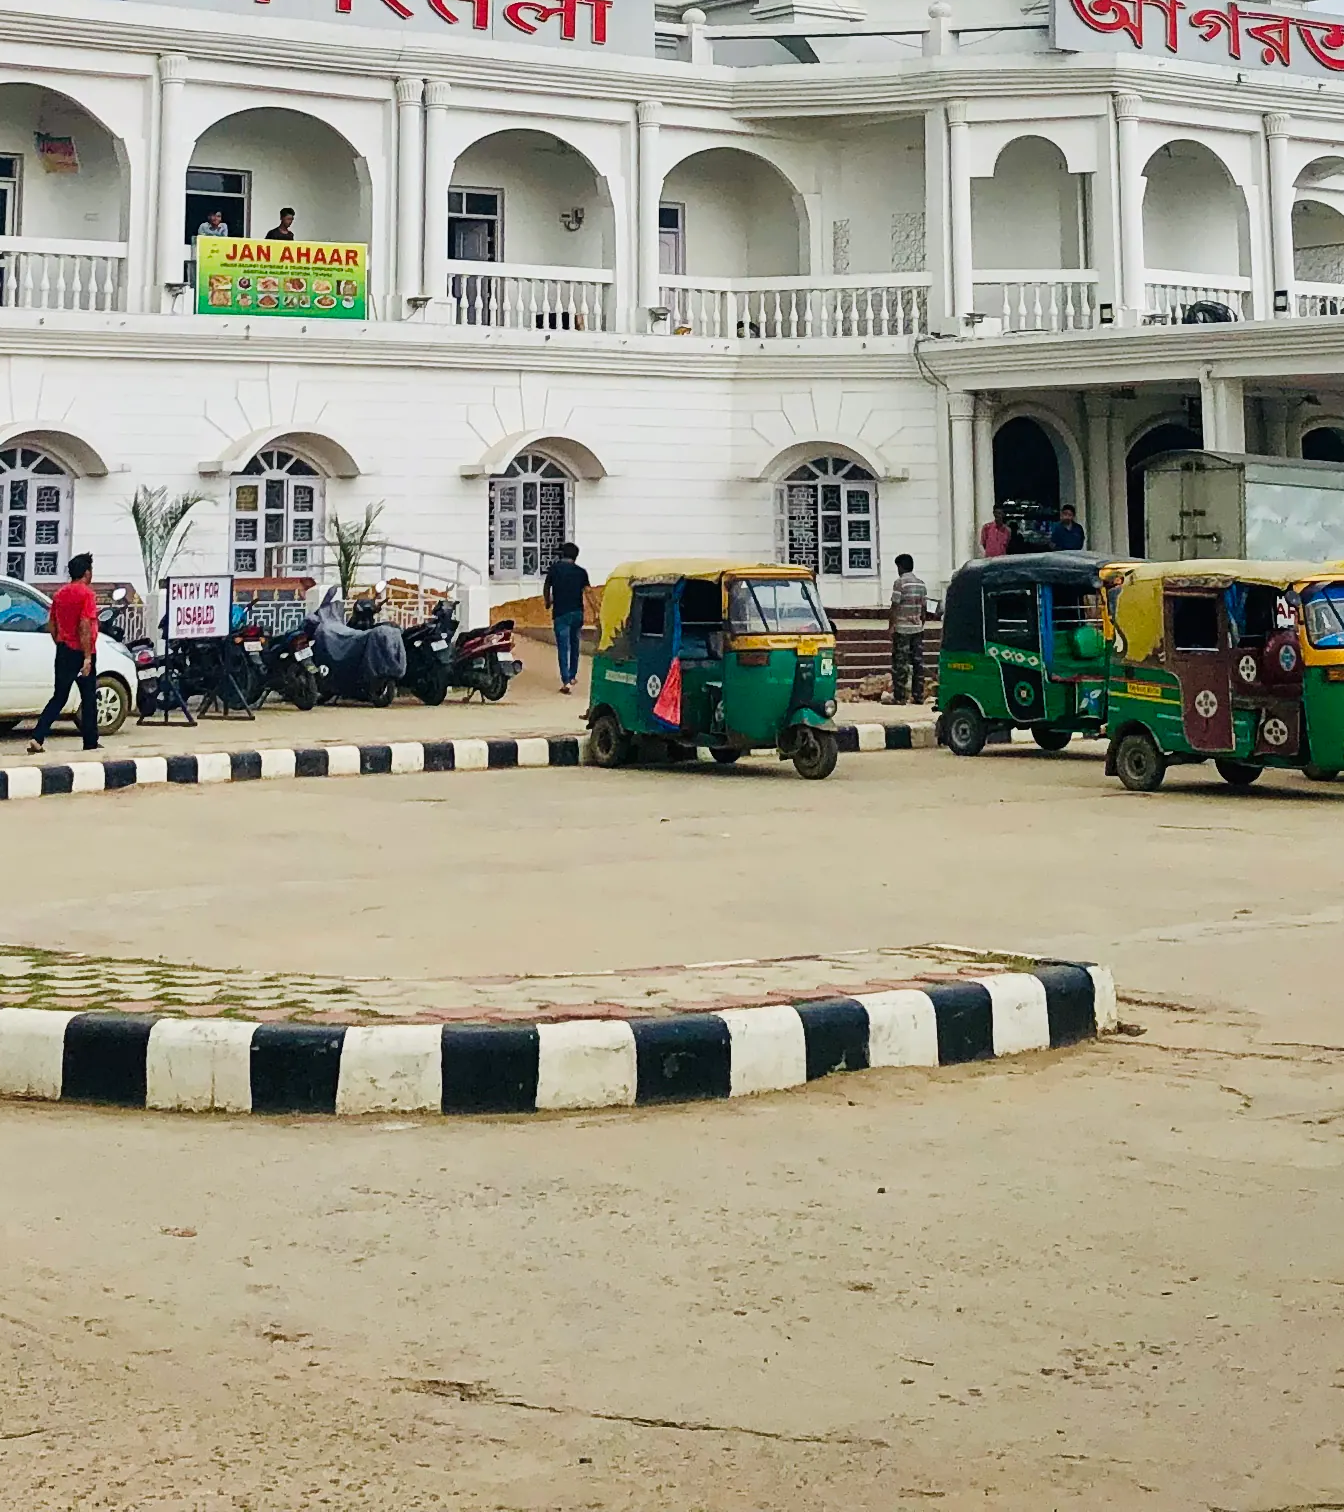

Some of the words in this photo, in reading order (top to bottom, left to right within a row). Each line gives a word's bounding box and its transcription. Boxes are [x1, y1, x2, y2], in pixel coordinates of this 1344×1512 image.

[225, 243, 271, 263] JAN
[279, 246, 359, 266] AHAAR
[171, 582, 201, 600] ENTRY
[204, 581, 219, 599] FOR
[176, 605, 215, 626] DISABLED
